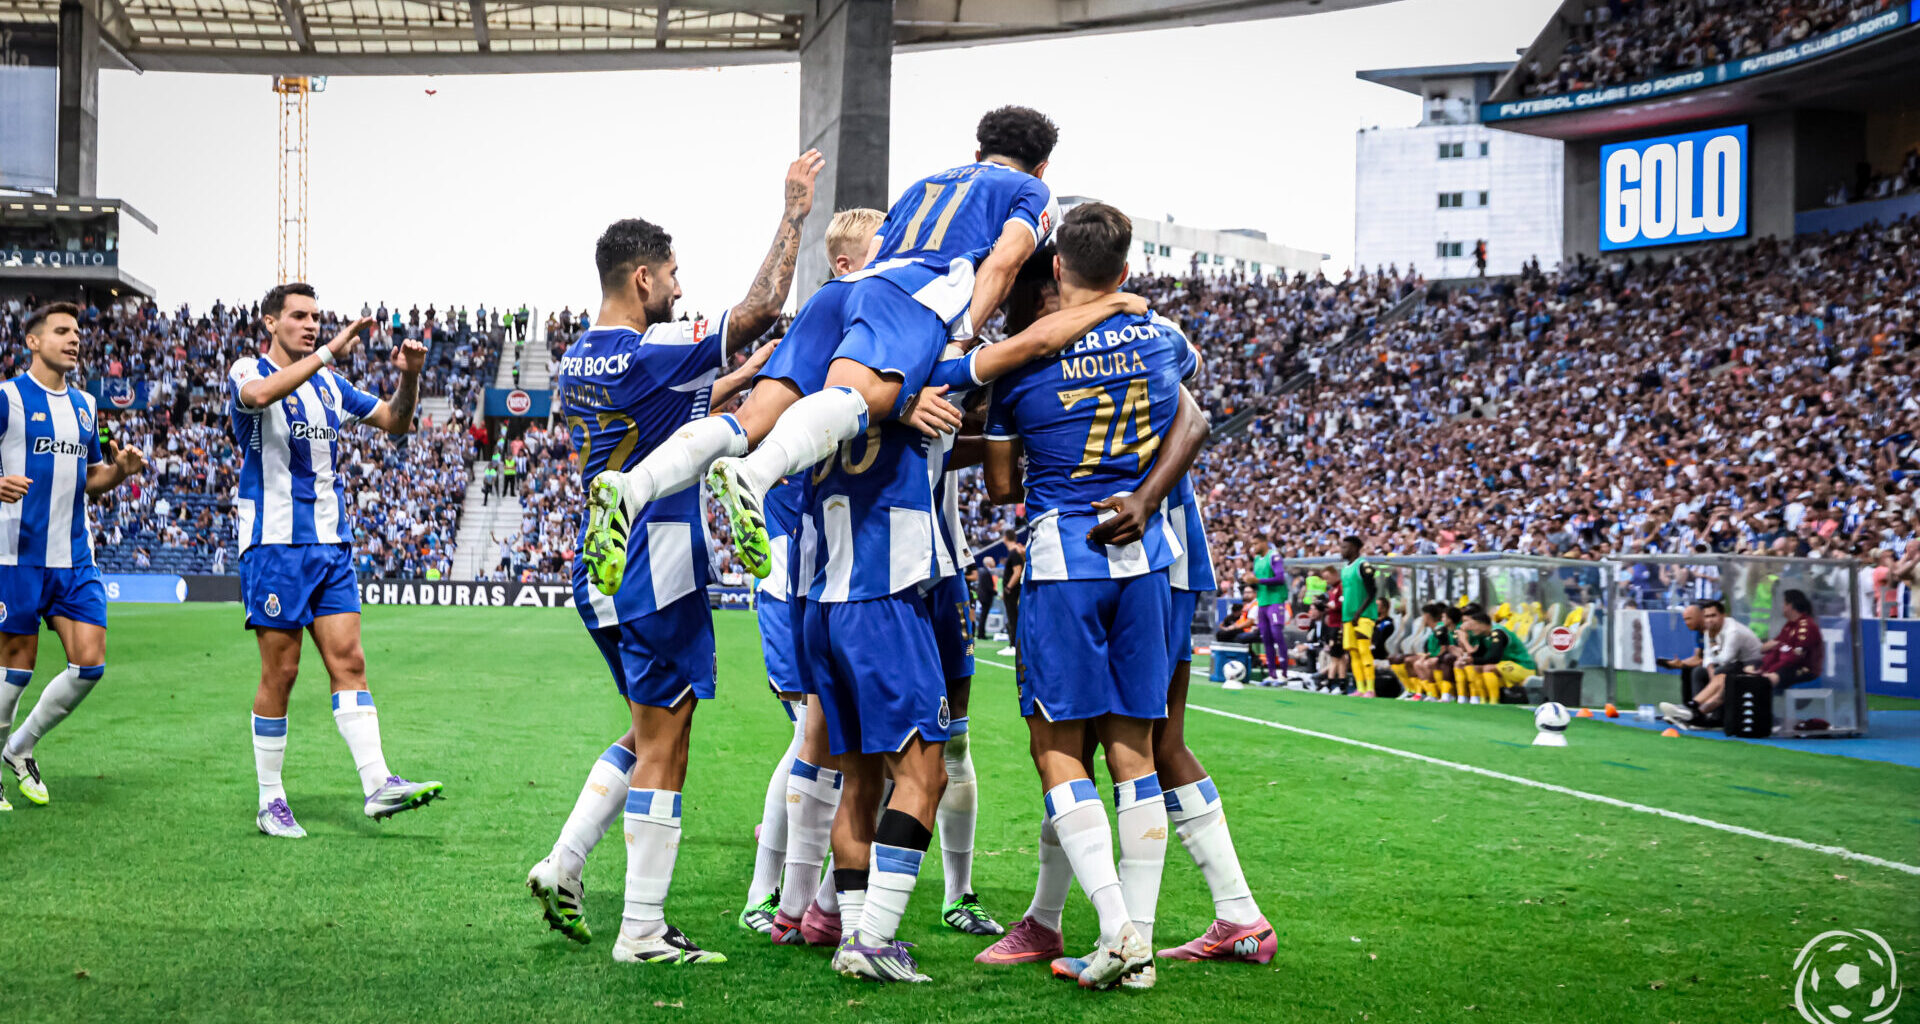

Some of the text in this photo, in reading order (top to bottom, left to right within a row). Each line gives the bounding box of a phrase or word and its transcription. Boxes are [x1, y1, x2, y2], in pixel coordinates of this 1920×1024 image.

[1500, 71, 1704, 117] FUTEBOL CLUBE DO PORTO
[1605, 135, 1741, 243] GOLO
[894, 180, 974, 254] 11
[585, 353, 632, 377] BOCK
[1061, 350, 1148, 380] MOURA
[292, 421, 337, 441] Betano
[1057, 378, 1160, 478] 74
[33, 437, 88, 459] Betano
